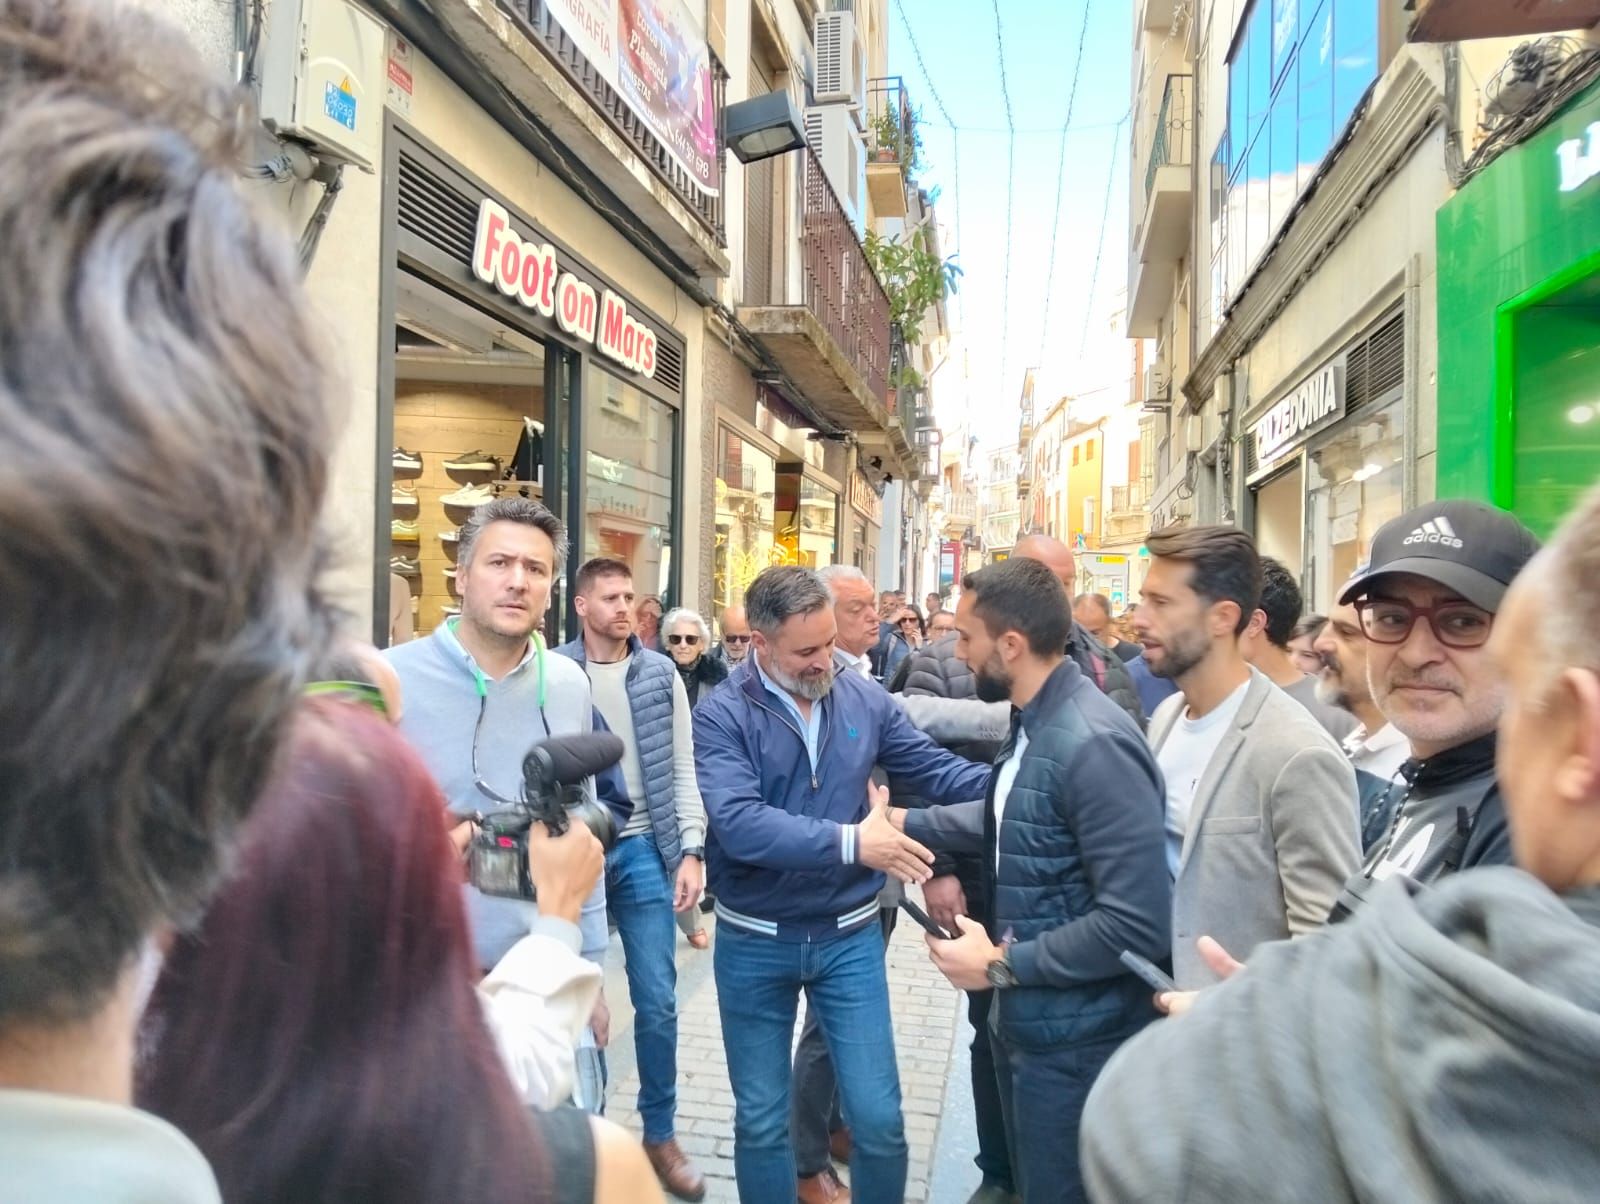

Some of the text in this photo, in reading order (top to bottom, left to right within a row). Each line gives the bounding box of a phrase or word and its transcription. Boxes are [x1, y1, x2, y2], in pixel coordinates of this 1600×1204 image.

[481, 208, 655, 371] Foot on Mars
[1255, 365, 1337, 459] CALZEDONIA
[1402, 532, 1464, 549] adidas
